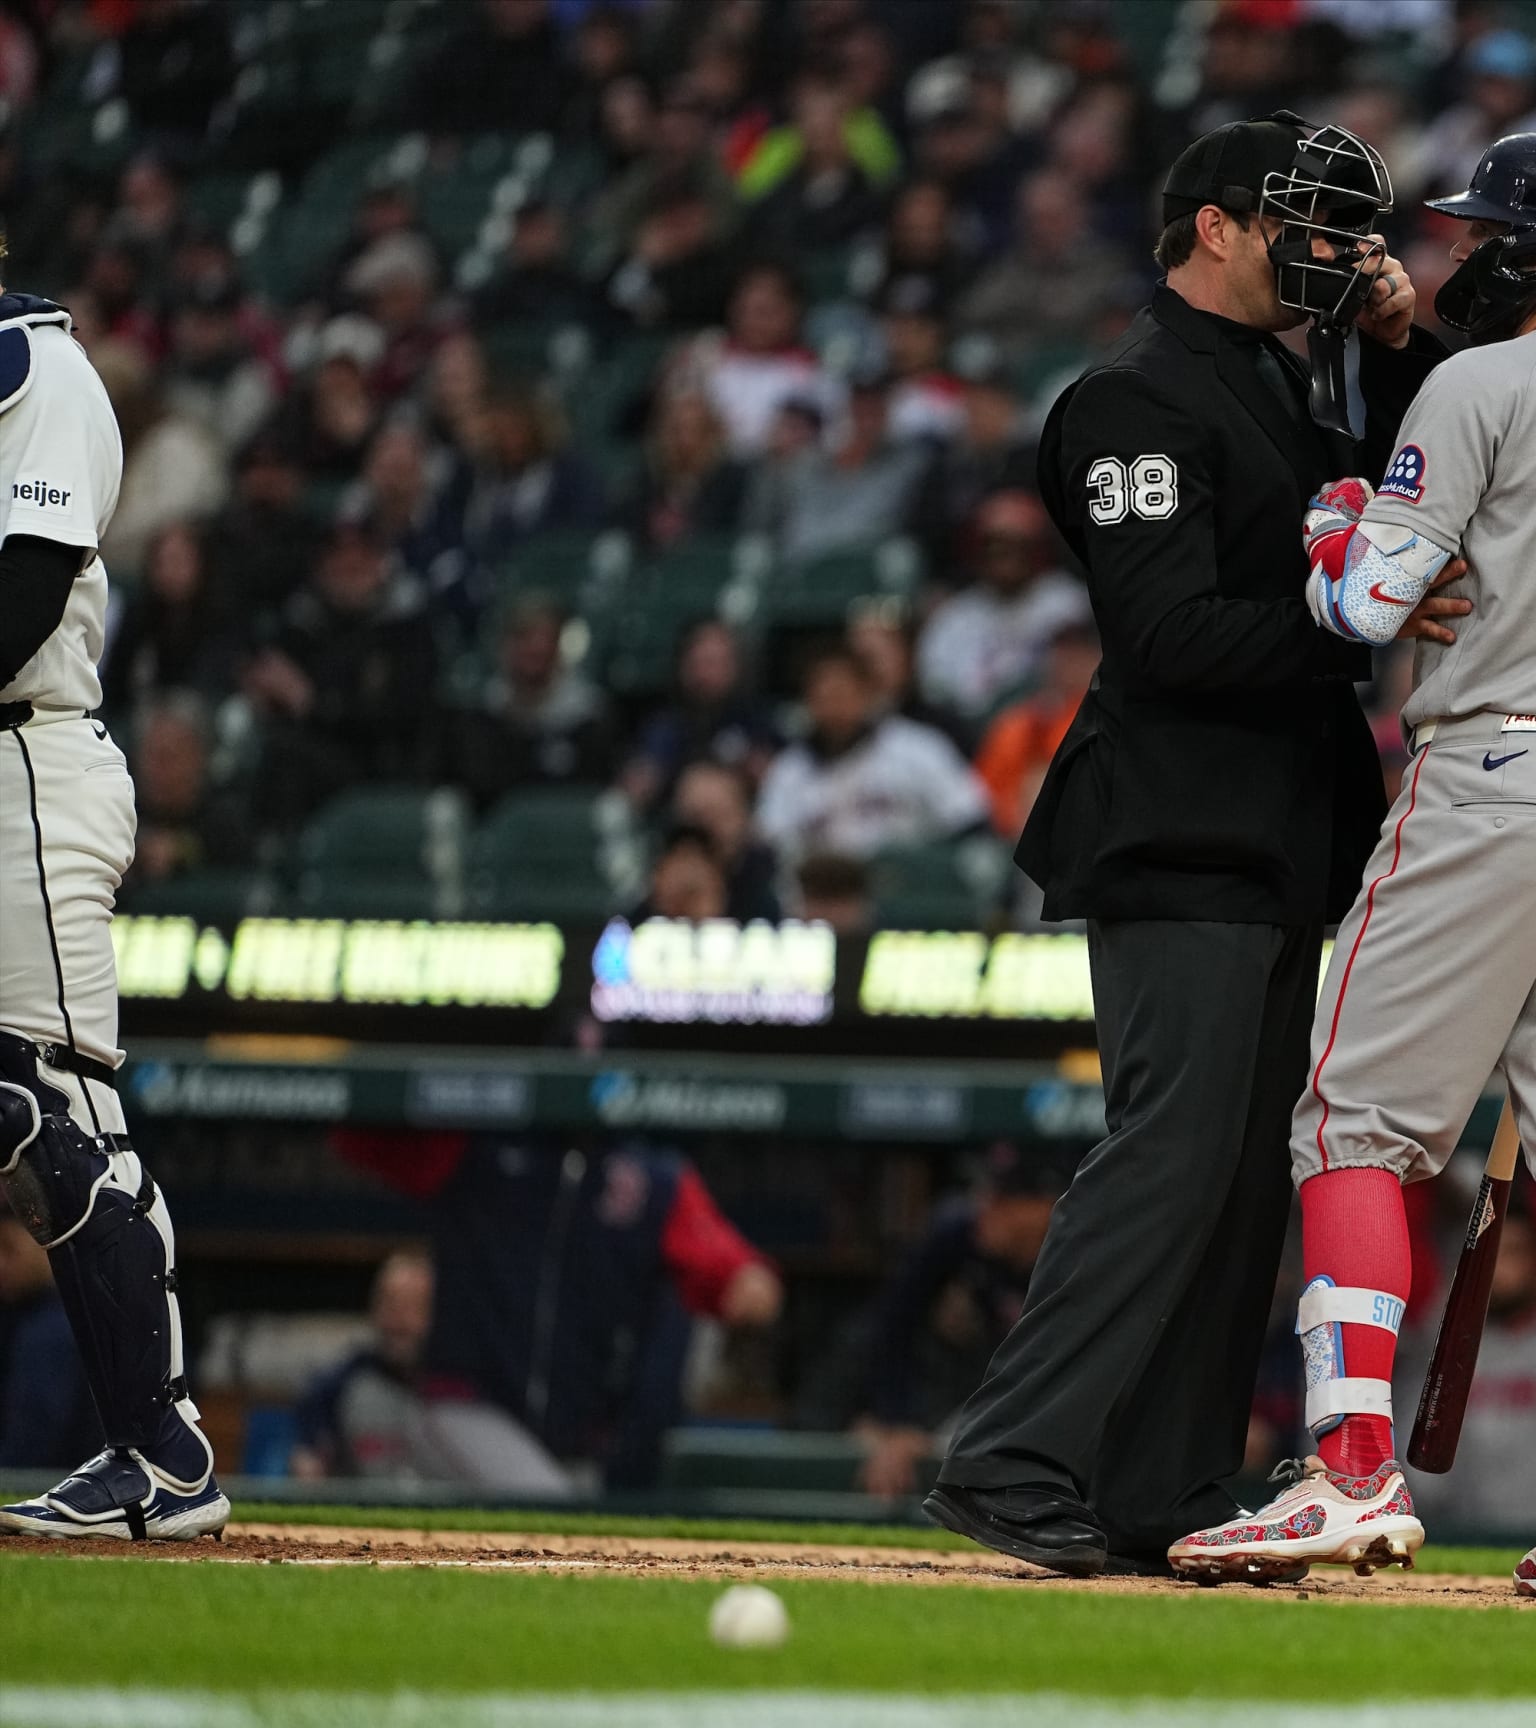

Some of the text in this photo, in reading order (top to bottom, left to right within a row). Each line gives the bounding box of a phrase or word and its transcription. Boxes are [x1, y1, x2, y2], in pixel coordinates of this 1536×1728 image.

[1086, 453, 1178, 526] 38
[1378, 481, 1420, 499] assMutual
[1372, 1295, 1404, 1331] STO
